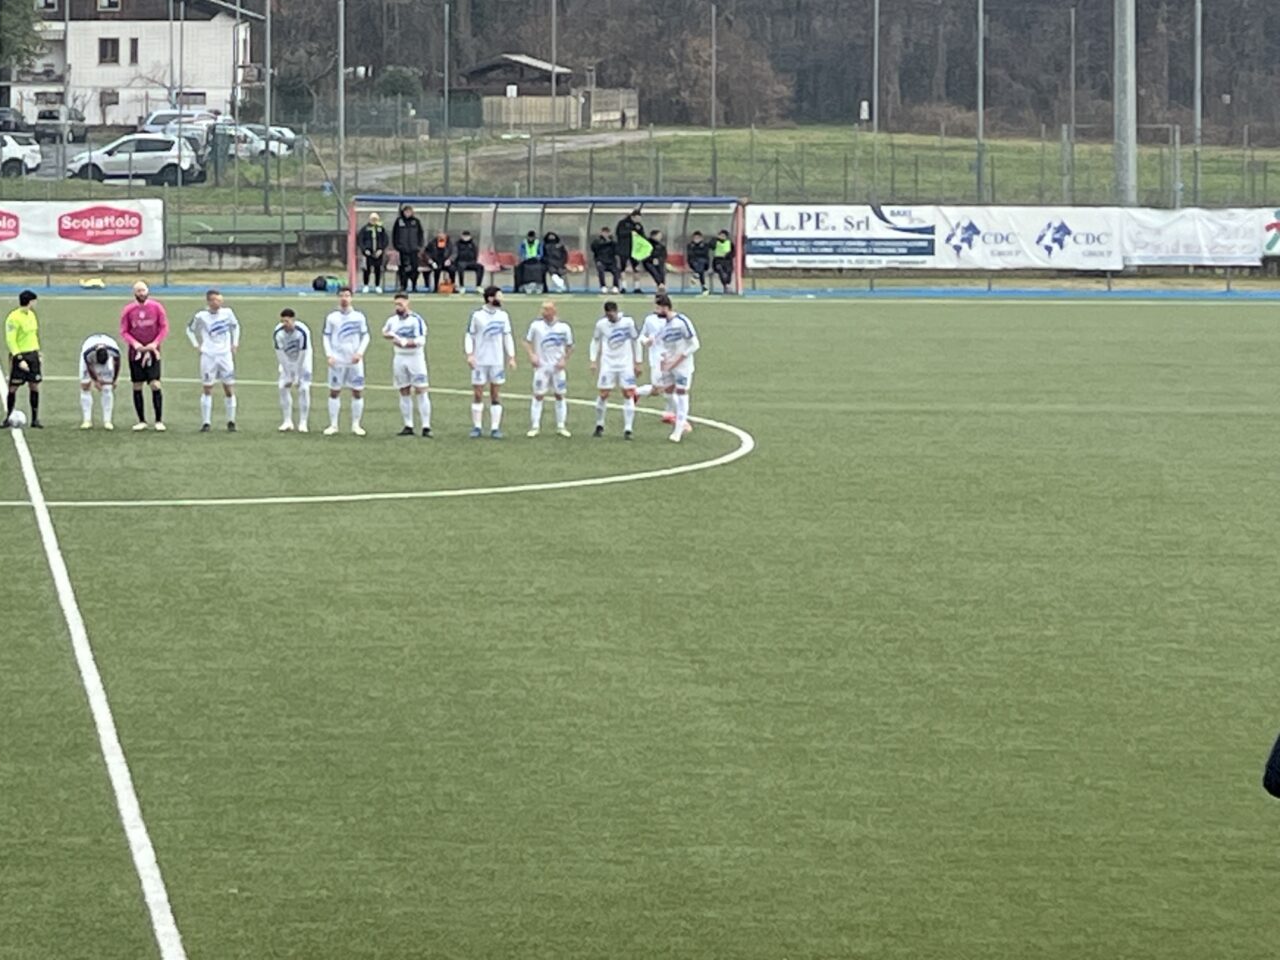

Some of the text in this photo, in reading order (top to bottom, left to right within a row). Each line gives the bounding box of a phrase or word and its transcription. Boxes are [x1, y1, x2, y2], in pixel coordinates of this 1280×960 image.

[61, 214, 140, 229] Scoiattolo
[753, 211, 870, 231] AL.PE. Srl
[982, 231, 1017, 245] CDC
[1073, 231, 1108, 245] CDC
